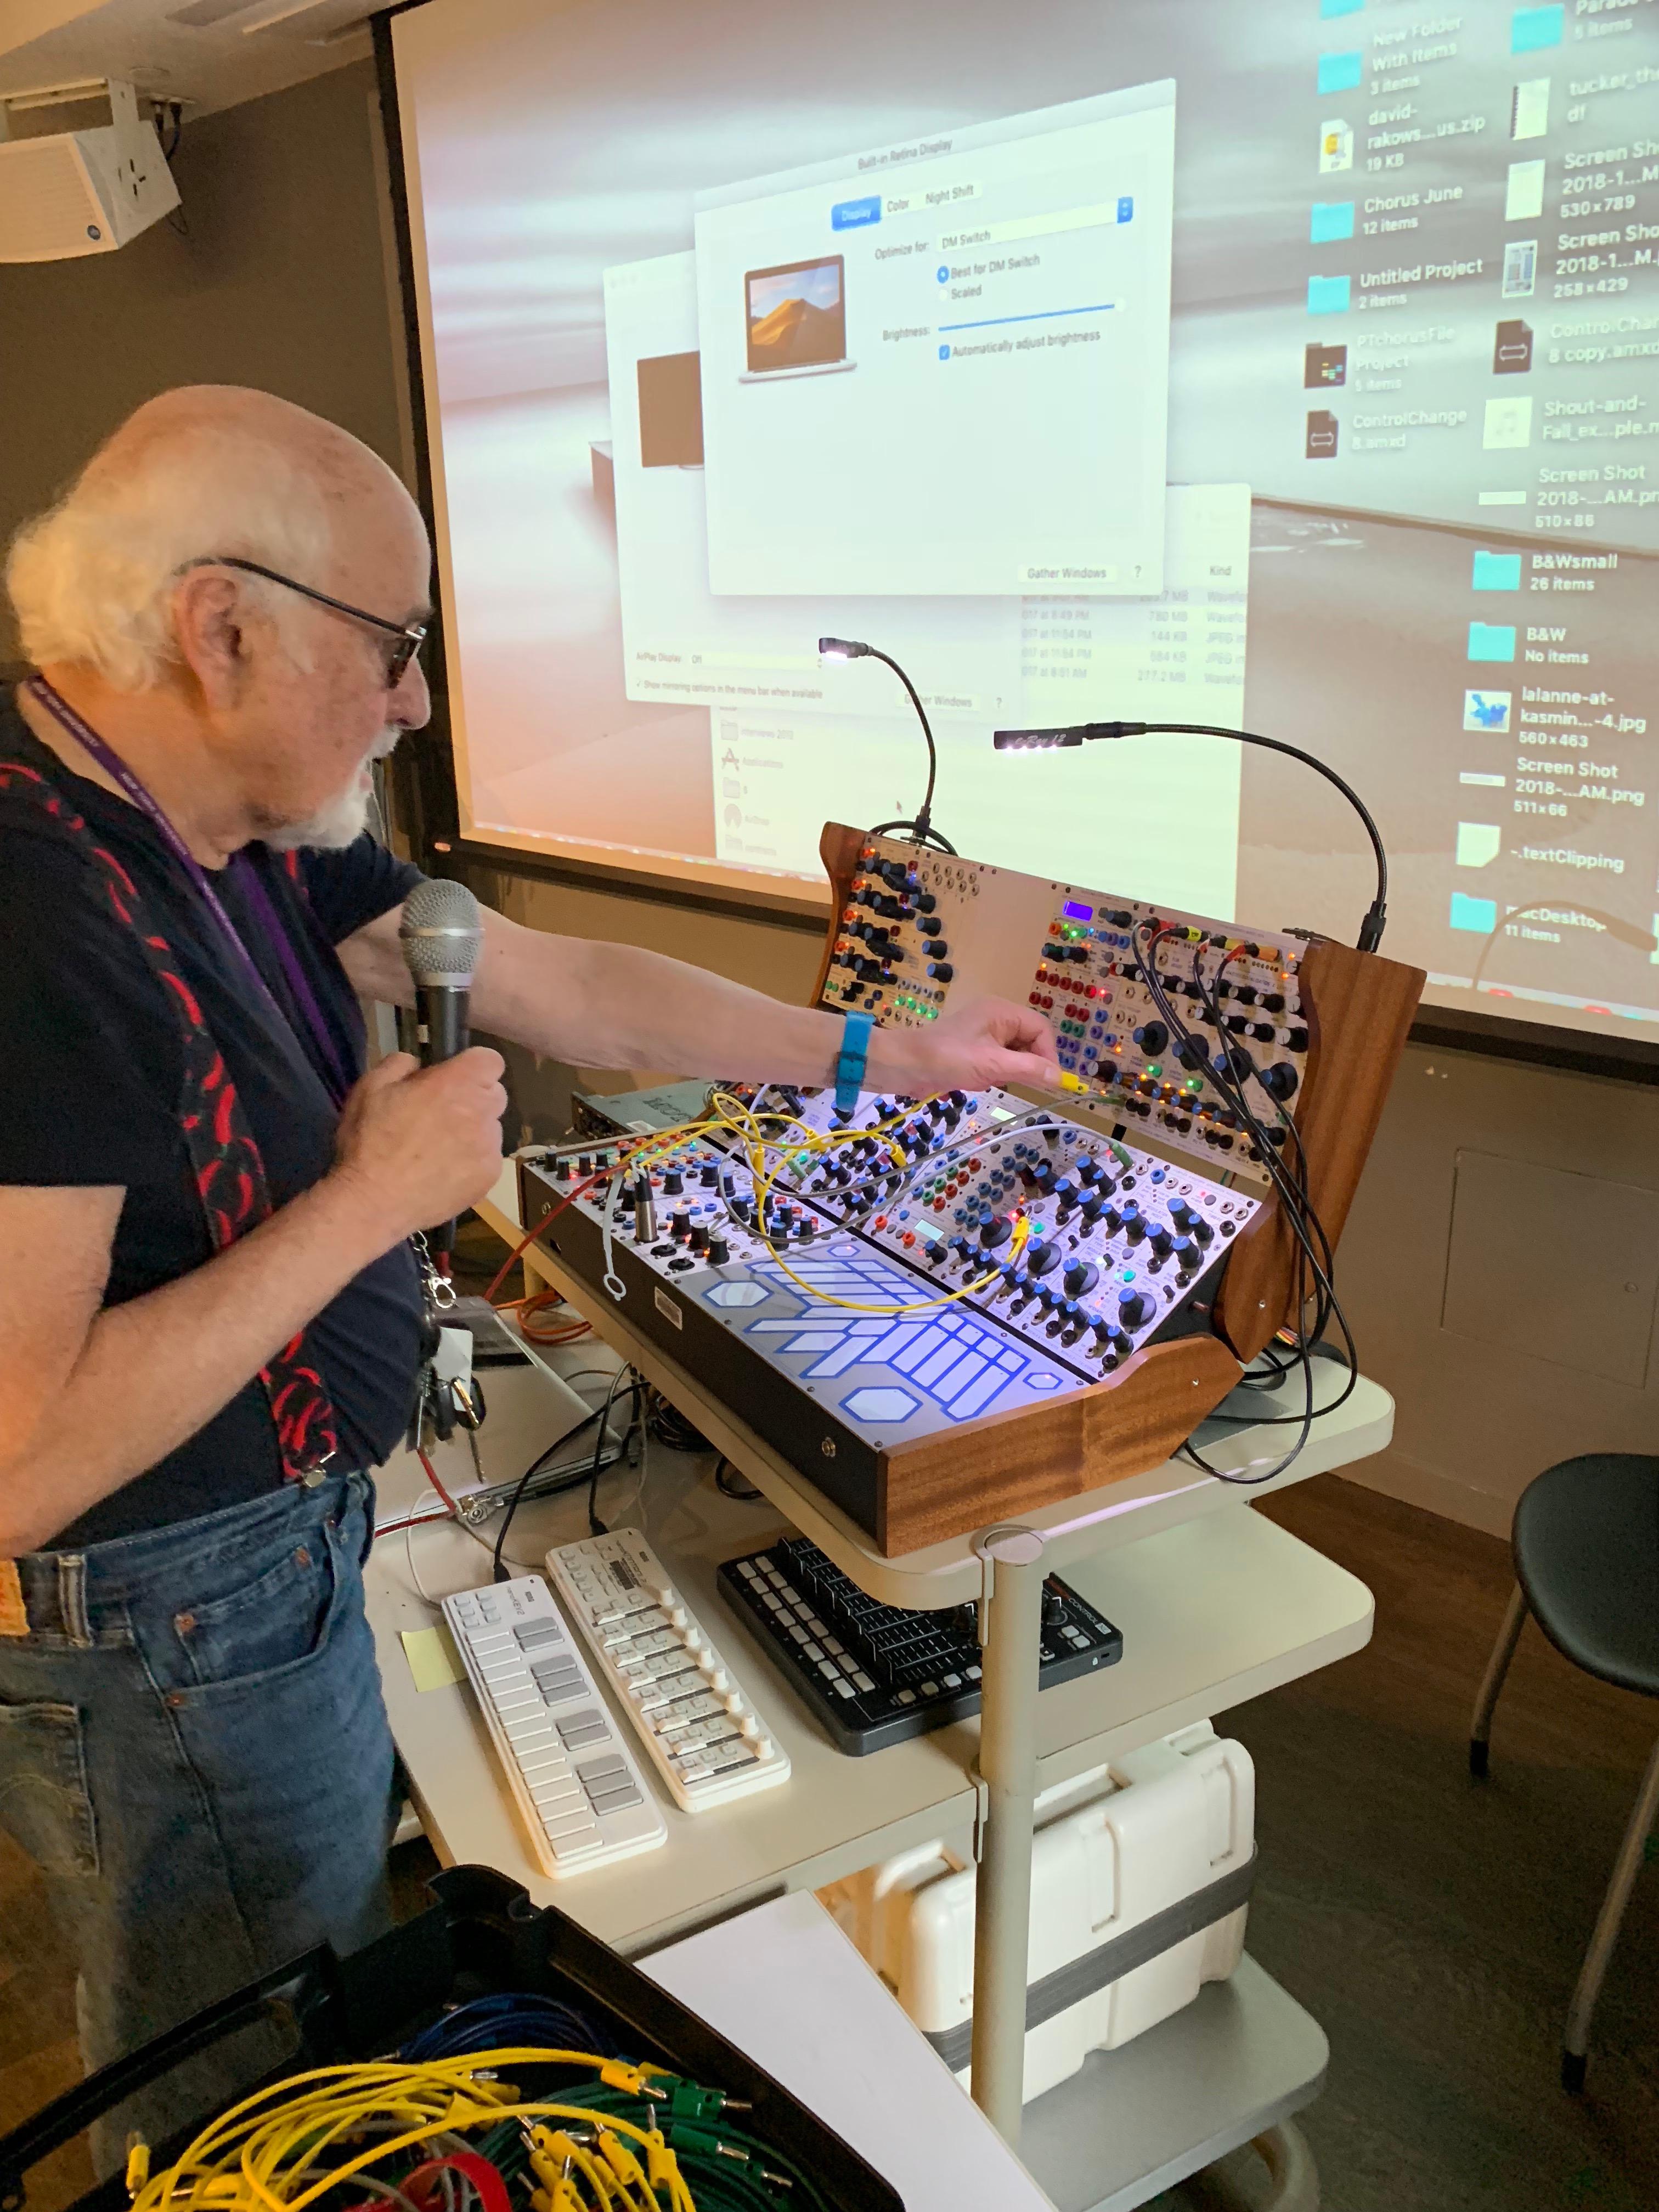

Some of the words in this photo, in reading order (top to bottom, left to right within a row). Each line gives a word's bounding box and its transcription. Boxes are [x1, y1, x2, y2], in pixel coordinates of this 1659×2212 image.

[1372, 53, 1408, 72] With
[1367, 156, 1382, 172] 19
[1385, 153, 1404, 168] KB
[1564, 147, 1628, 170] Screen
[887, 199, 910, 212] Color
[926, 190, 950, 205] Night
[952, 184, 974, 199] Shift
[1364, 193, 1420, 213] Chorus
[1424, 185, 1463, 204] June
[1363, 221, 1378, 235] 12
[1381, 217, 1419, 233] items
[874, 244, 912, 261] Optimize
[942, 236, 958, 249] DM
[960, 230, 991, 246] Switch
[1558, 230, 1621, 250] Screen
[951, 266, 972, 279] Best
[974, 262, 986, 275] for
[989, 259, 1005, 273] DM
[1008, 253, 1041, 270] Switch
[1360, 265, 1421, 288] Untitled
[1425, 258, 1483, 280] Project
[951, 285, 982, 300] Scaled
[1359, 295, 1367, 309] 2
[1370, 294, 1407, 308] items
[952, 340, 1013, 358] Automatically
[1016, 336, 1045, 351] adjust
[1047, 330, 1101, 347] brightness
[1538, 467, 1599, 483] Screen
[1604, 465, 1646, 481] Shot
[1532, 554, 1618, 569] B&Wsmall
[1028, 567, 1059, 579] Gather
[1062, 567, 1107, 579] Windows
[1209, 565, 1232, 577] Kind
[1530, 577, 1549, 591] 26
[1553, 575, 1595, 591] items
[1527, 627, 1567, 642] B&W
[1525, 649, 1545, 663] No
[1548, 648, 1589, 664] items
[1517, 757, 1574, 775] Screen
[1578, 761, 1619, 779] Shot
[1521, 925, 1561, 943] items
